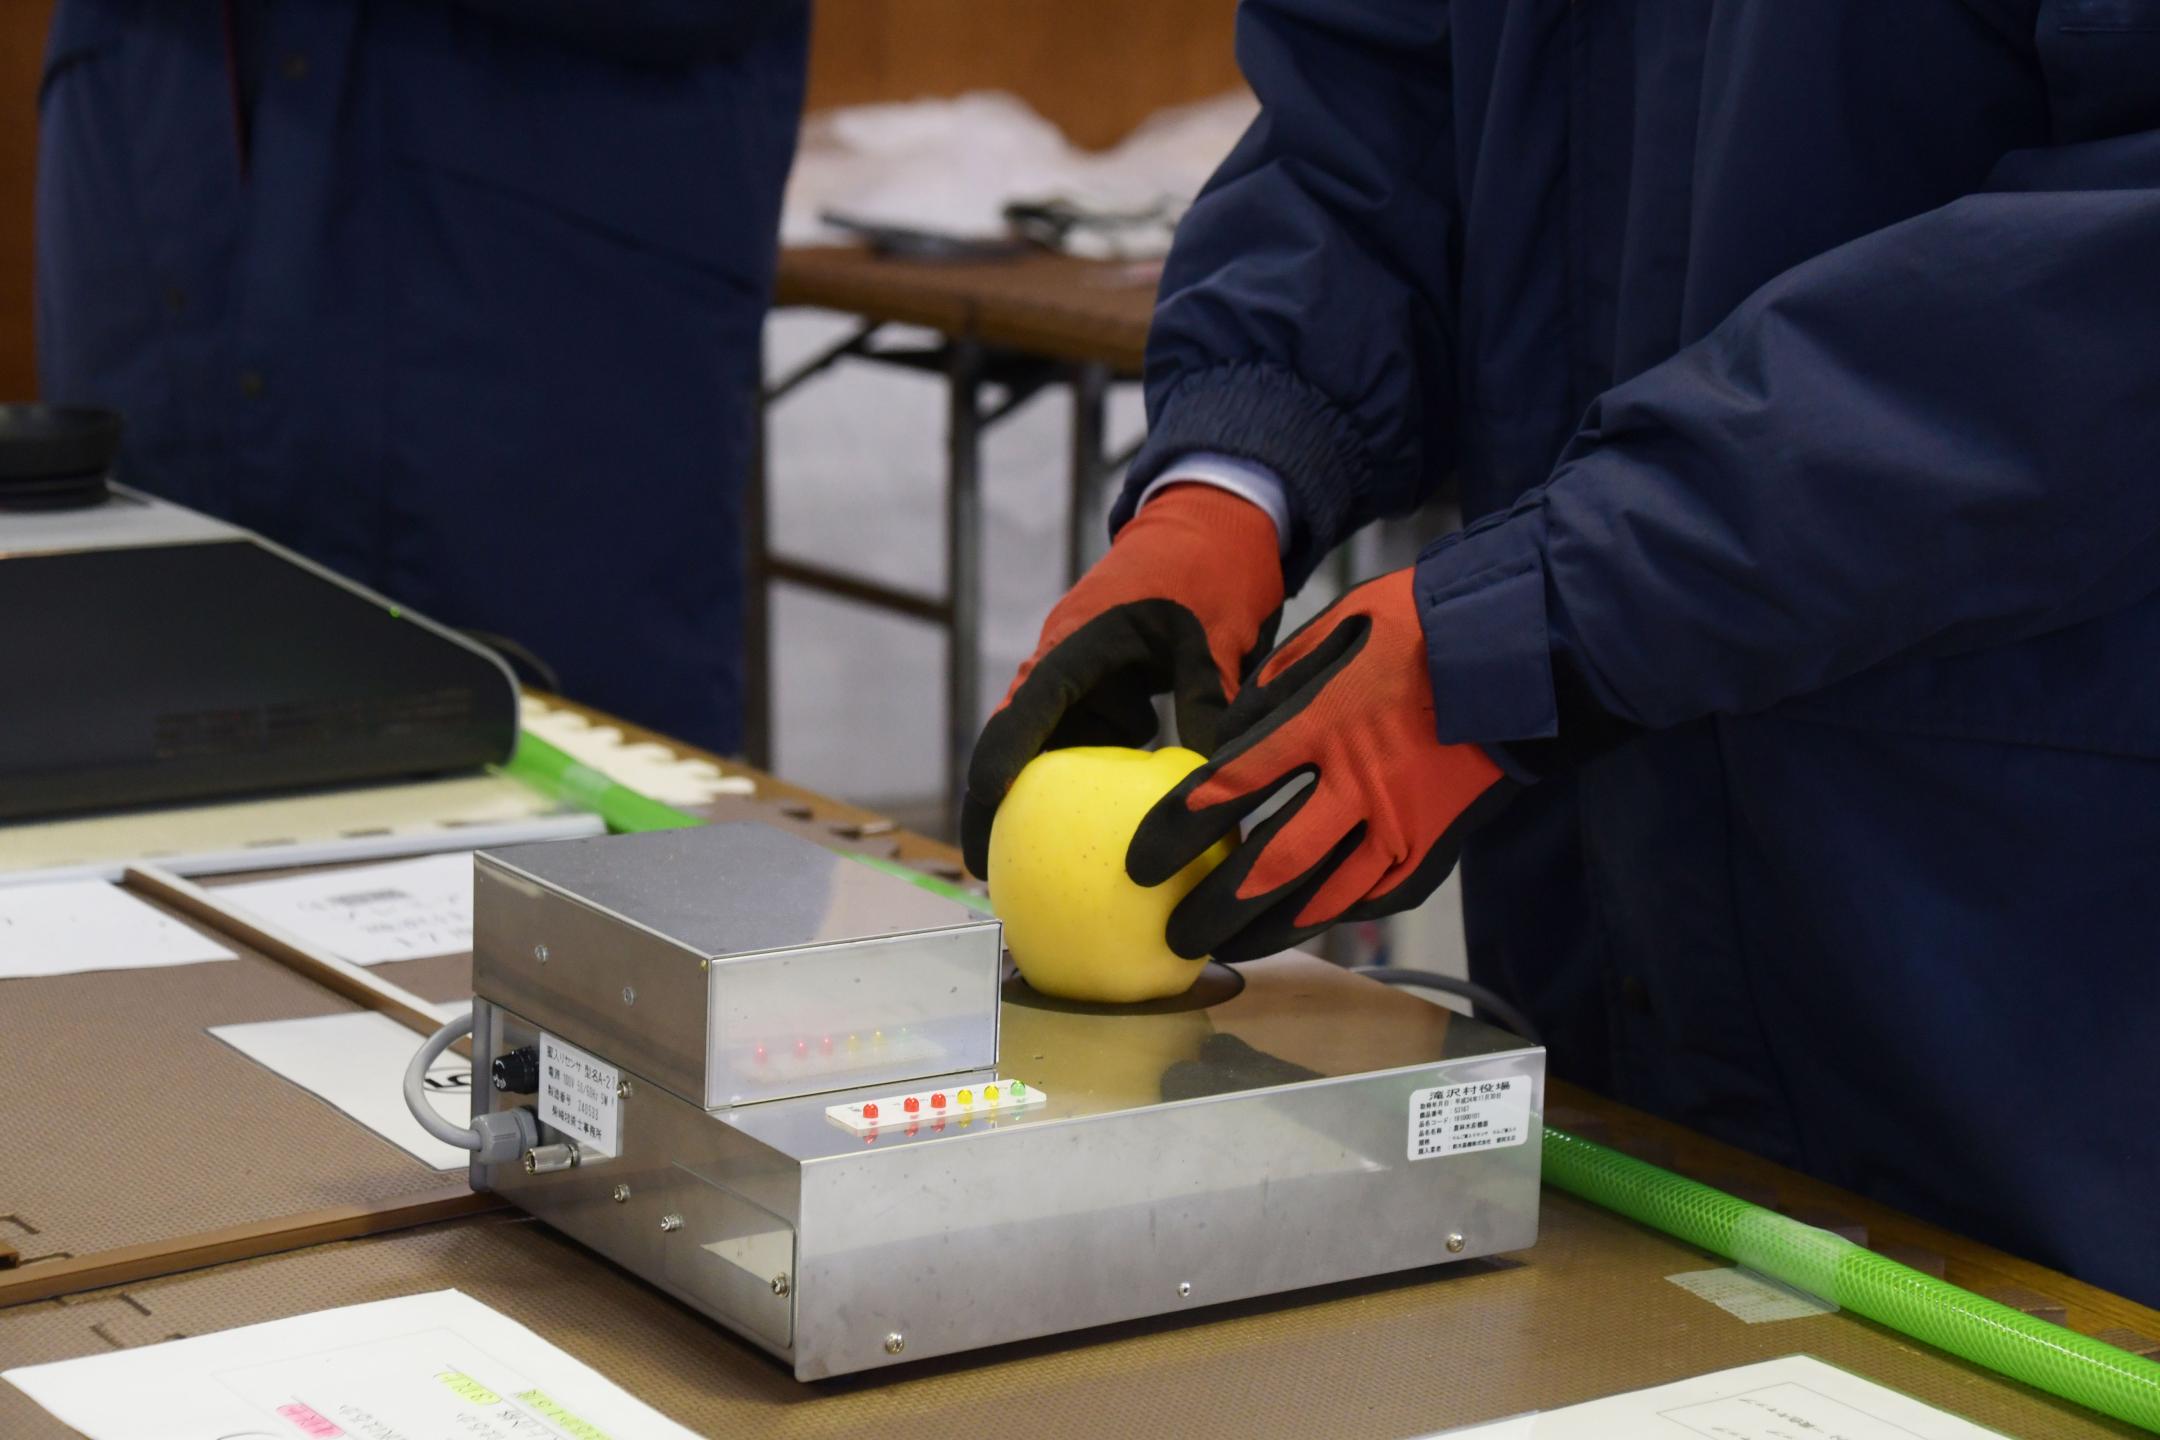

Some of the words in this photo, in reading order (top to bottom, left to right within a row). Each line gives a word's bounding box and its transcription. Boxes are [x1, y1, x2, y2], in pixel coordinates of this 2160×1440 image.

[1429, 1081, 1510, 1100] 滝沢村役場
